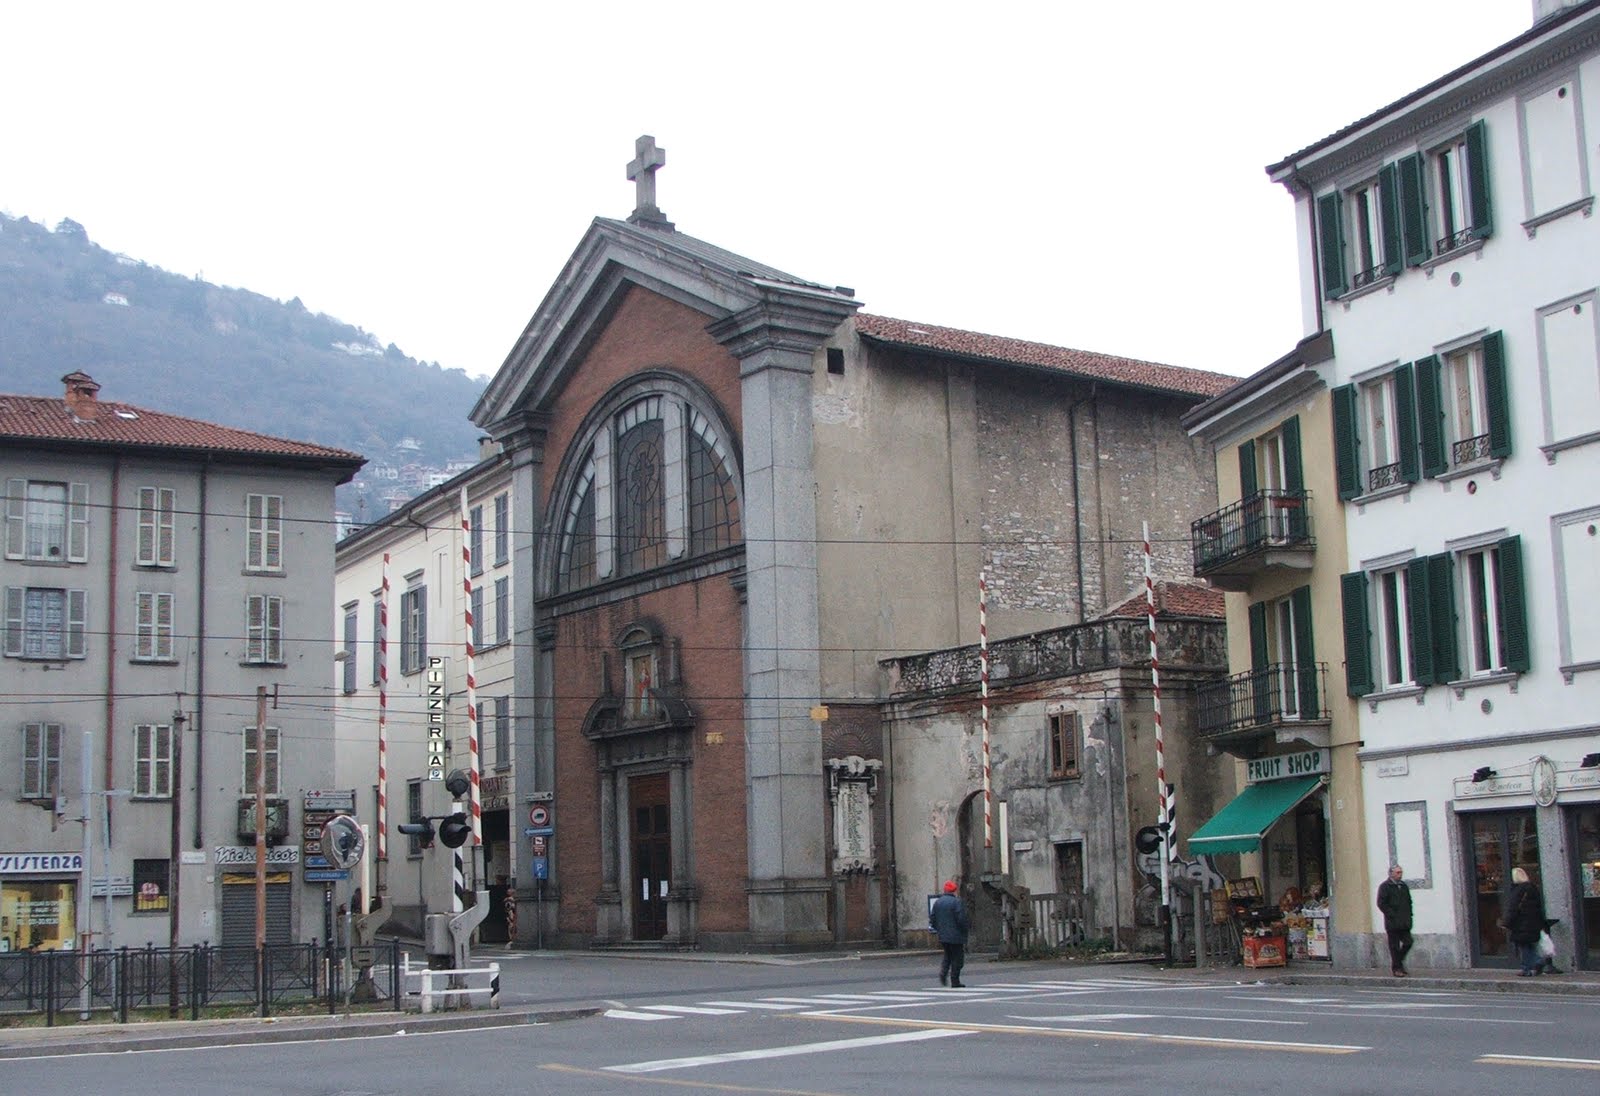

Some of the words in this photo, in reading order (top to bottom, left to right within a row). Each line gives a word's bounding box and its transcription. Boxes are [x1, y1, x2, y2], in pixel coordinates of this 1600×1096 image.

[429, 657, 442, 766] PIZZERIA
[1248, 758, 1281, 779] FRUIT
[1287, 751, 1320, 774] SHOP
